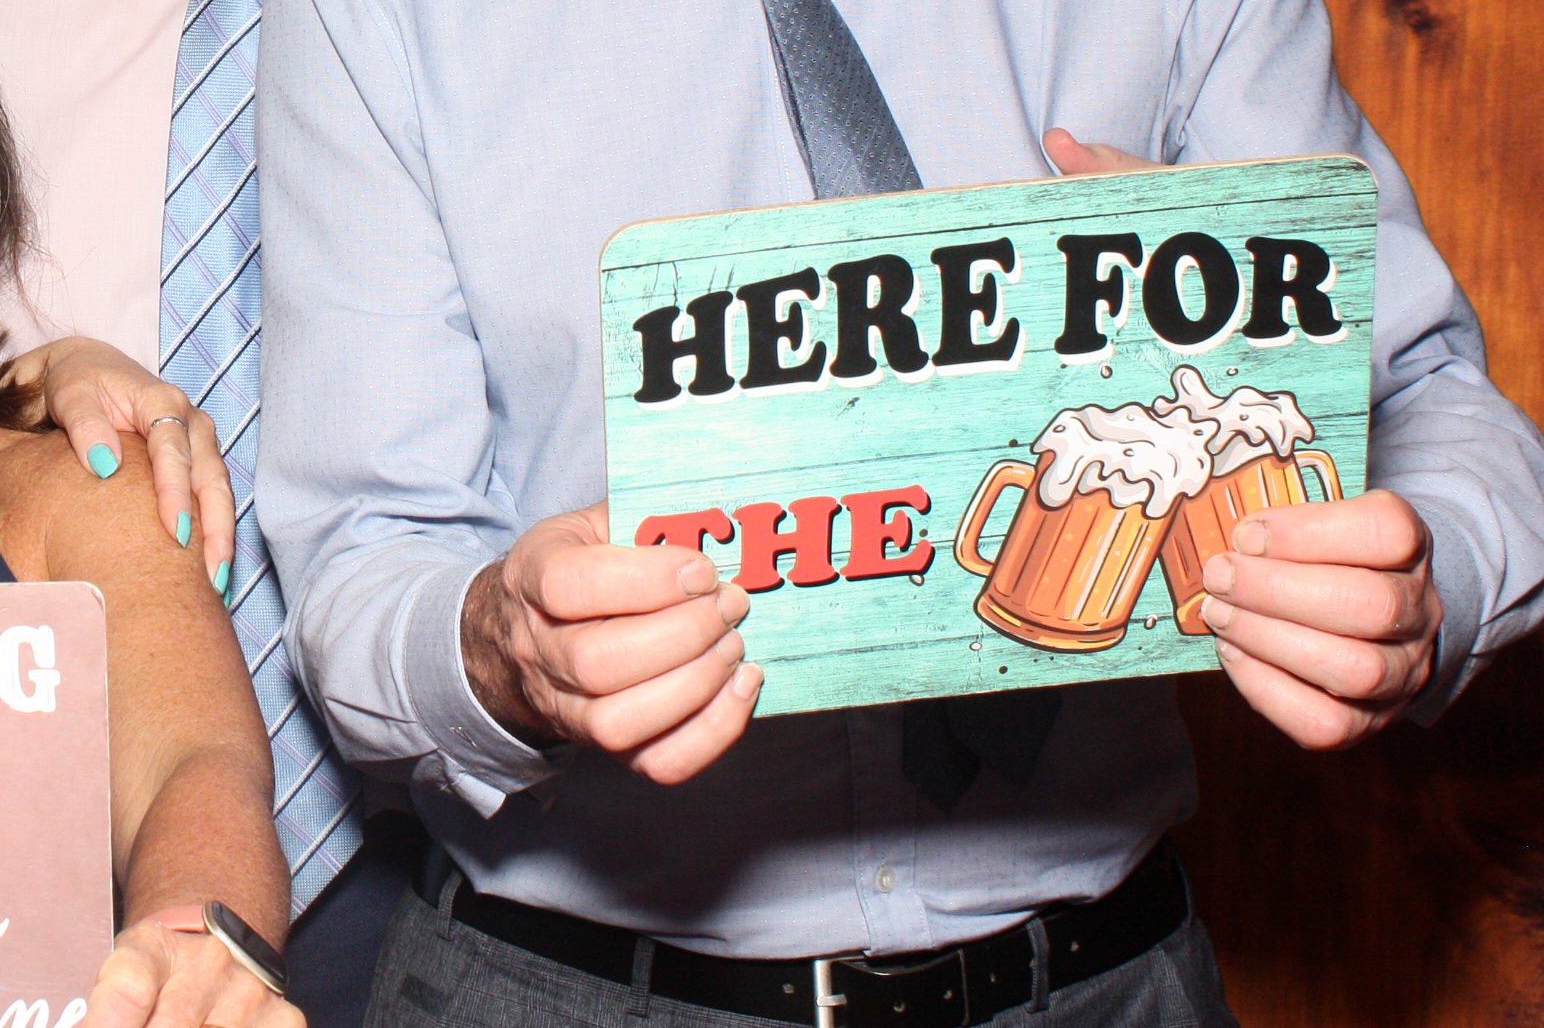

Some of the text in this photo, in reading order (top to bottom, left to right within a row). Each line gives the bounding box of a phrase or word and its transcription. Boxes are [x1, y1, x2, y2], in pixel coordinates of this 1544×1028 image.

[633, 232, 1347, 407] HERE FOR
[634, 484, 936, 594] THE
